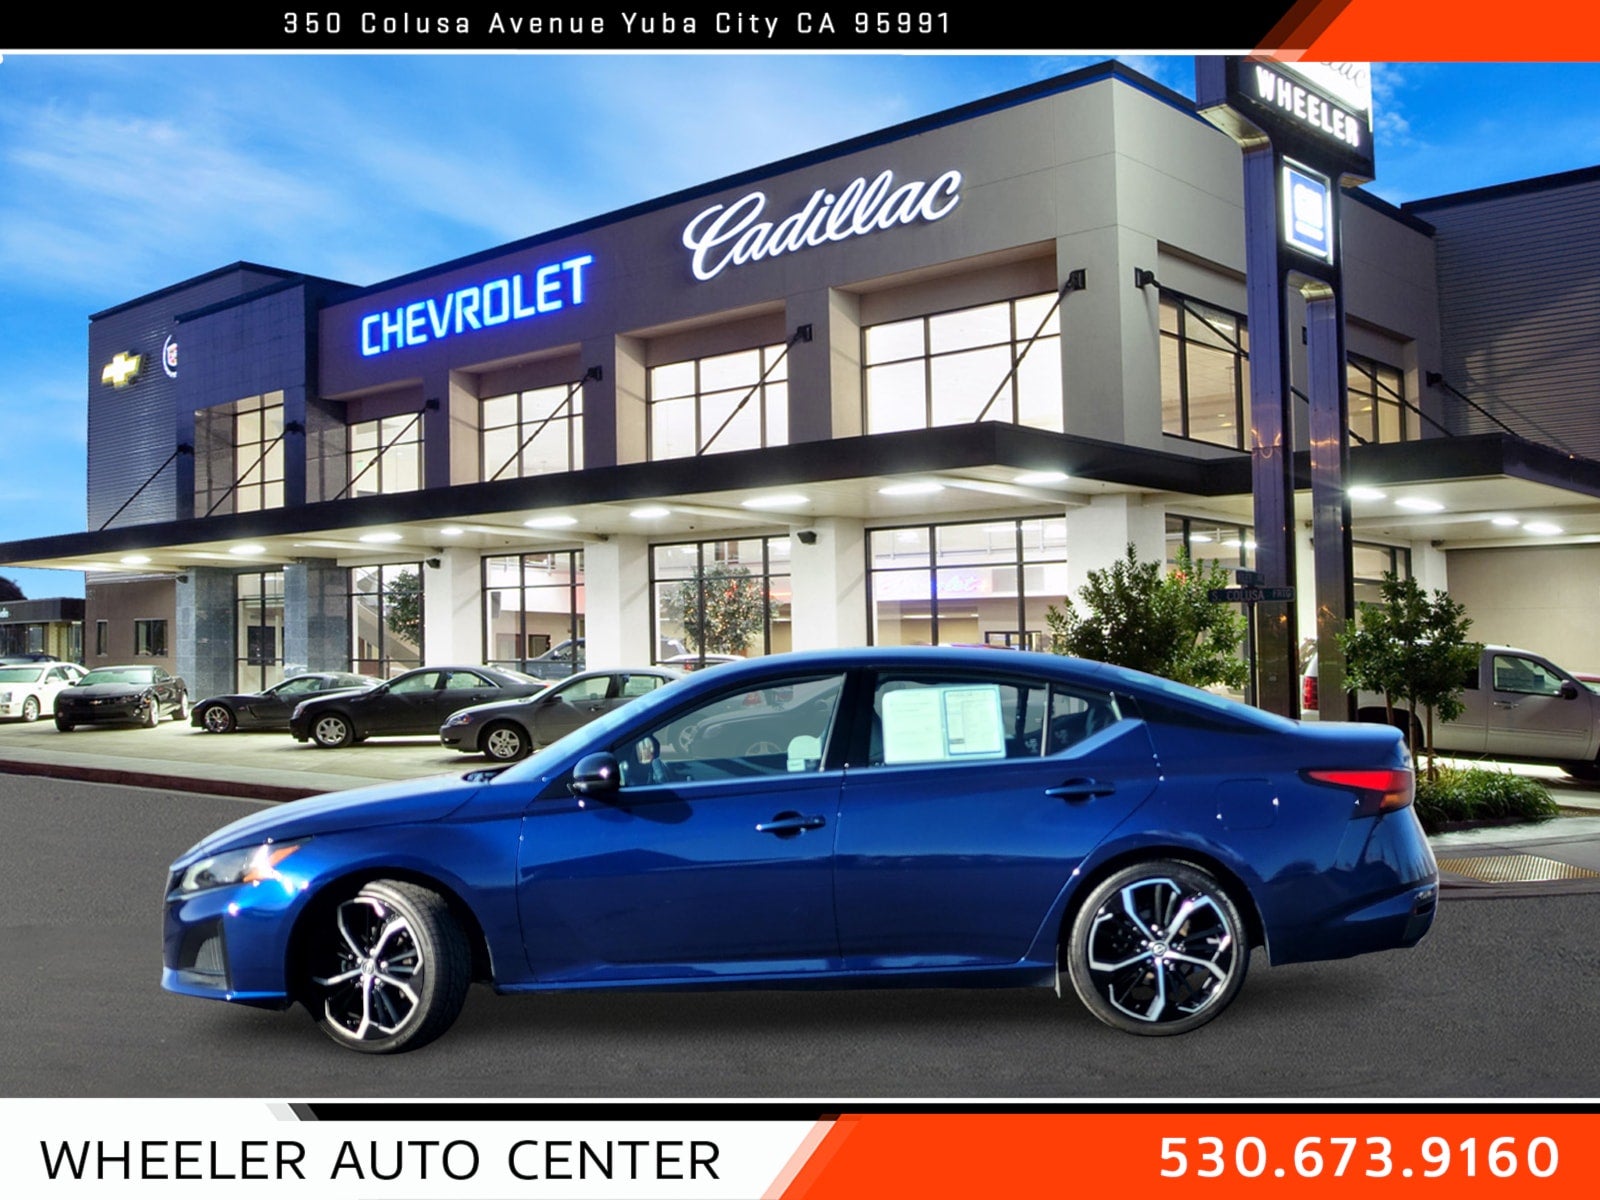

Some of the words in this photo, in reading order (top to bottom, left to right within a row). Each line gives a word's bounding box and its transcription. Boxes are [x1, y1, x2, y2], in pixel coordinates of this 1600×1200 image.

[1256, 65, 1360, 148] WHEELER
[682, 169, 962, 281] Cadillac
[361, 254, 593, 356] CHEVROLET
[1226, 590, 1265, 601] COLUSA
